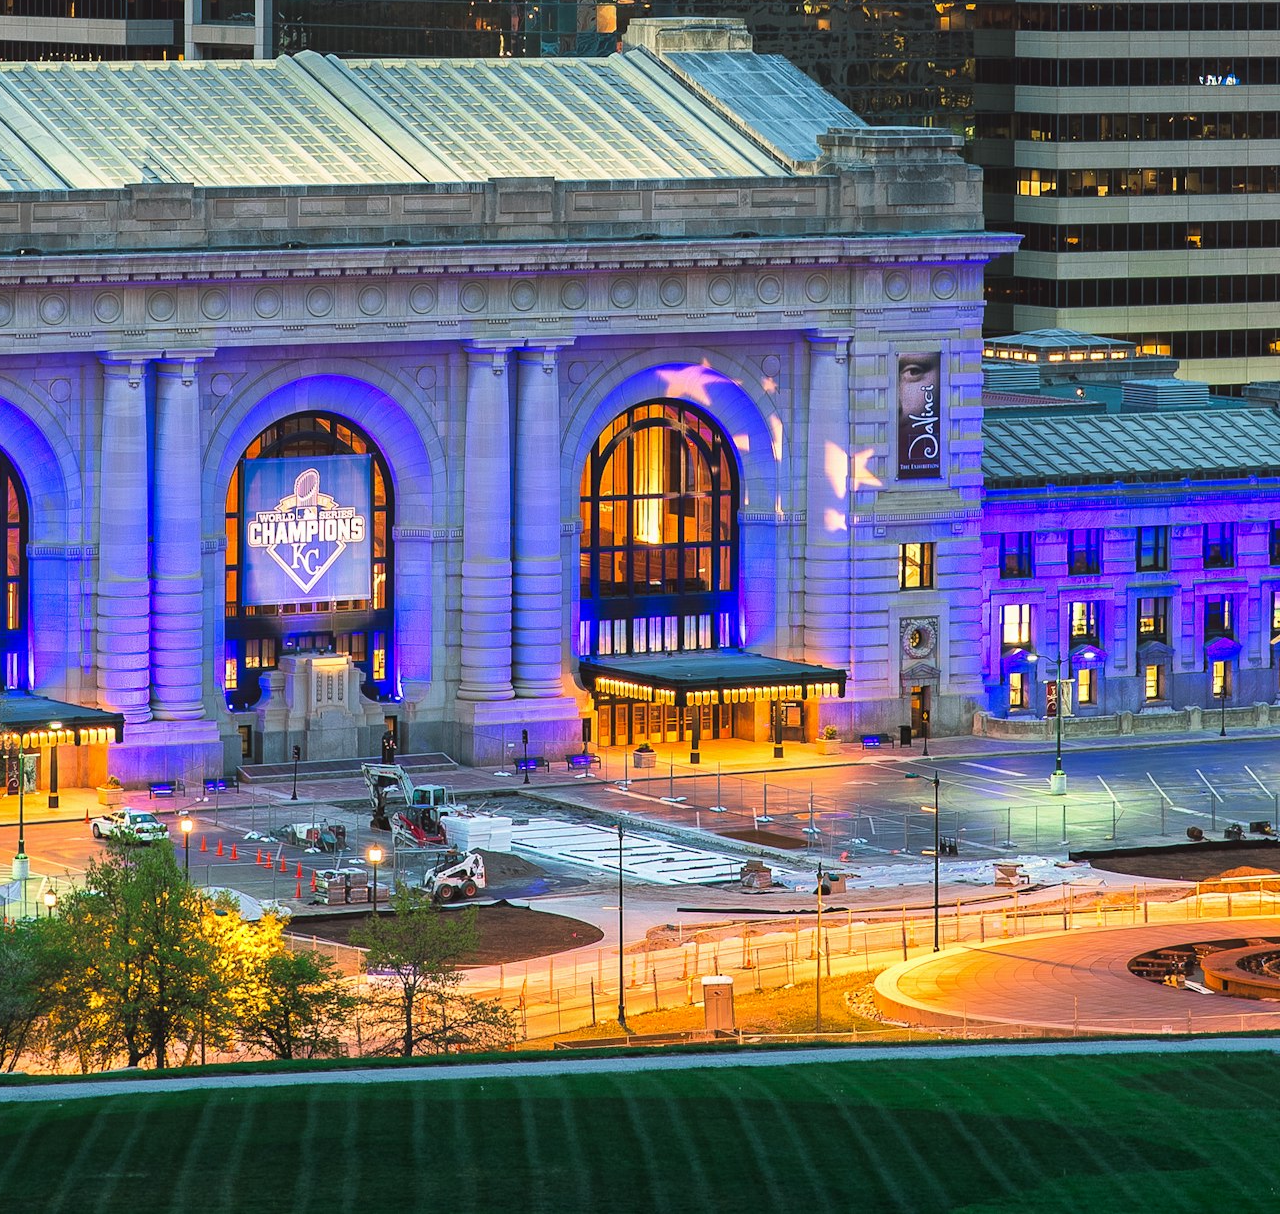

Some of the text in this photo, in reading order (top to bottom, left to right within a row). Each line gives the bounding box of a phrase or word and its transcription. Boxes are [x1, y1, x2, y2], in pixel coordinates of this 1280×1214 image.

[248, 516, 364, 547] CHAMPIONS
[258, 509, 355, 524] WORLD SERIES
[291, 543, 322, 575] KC
